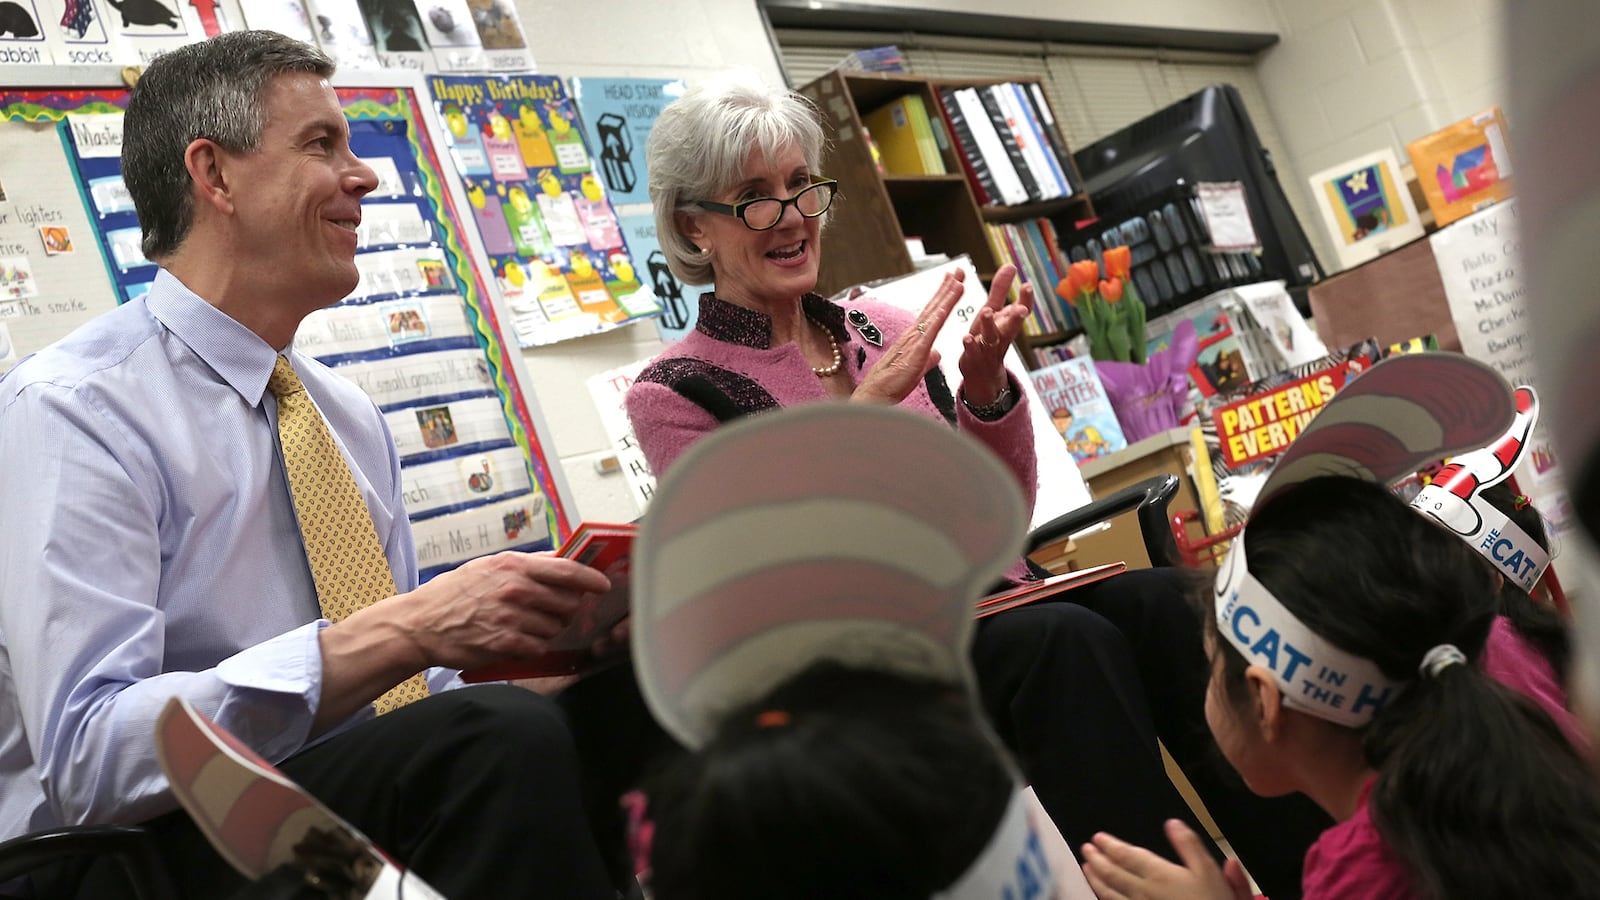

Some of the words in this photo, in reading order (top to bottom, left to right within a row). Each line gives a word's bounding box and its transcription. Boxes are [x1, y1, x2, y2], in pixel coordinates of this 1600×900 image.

[0, 49, 40, 63] abbit
[68, 48, 113, 63] socks
[432, 79, 483, 106] Happy
[486, 79, 561, 104] Birthday!
[604, 84, 634, 100] HEAD
[74, 122, 123, 147] Maste
[14, 204, 63, 228] lighters
[957, 305, 975, 323] go
[1221, 375, 1337, 436] PATTERNS
[1227, 406, 1322, 463] EVERYW
[402, 479, 430, 505] nch
[449, 529, 473, 554] Ms
[1481, 528, 1501, 550] THE
[1491, 538, 1537, 580] CAT
[1231, 605, 1313, 683] CAT
[1317, 665, 1347, 687] IN
[1302, 679, 1346, 708] THE
[1351, 682, 1392, 714] H
